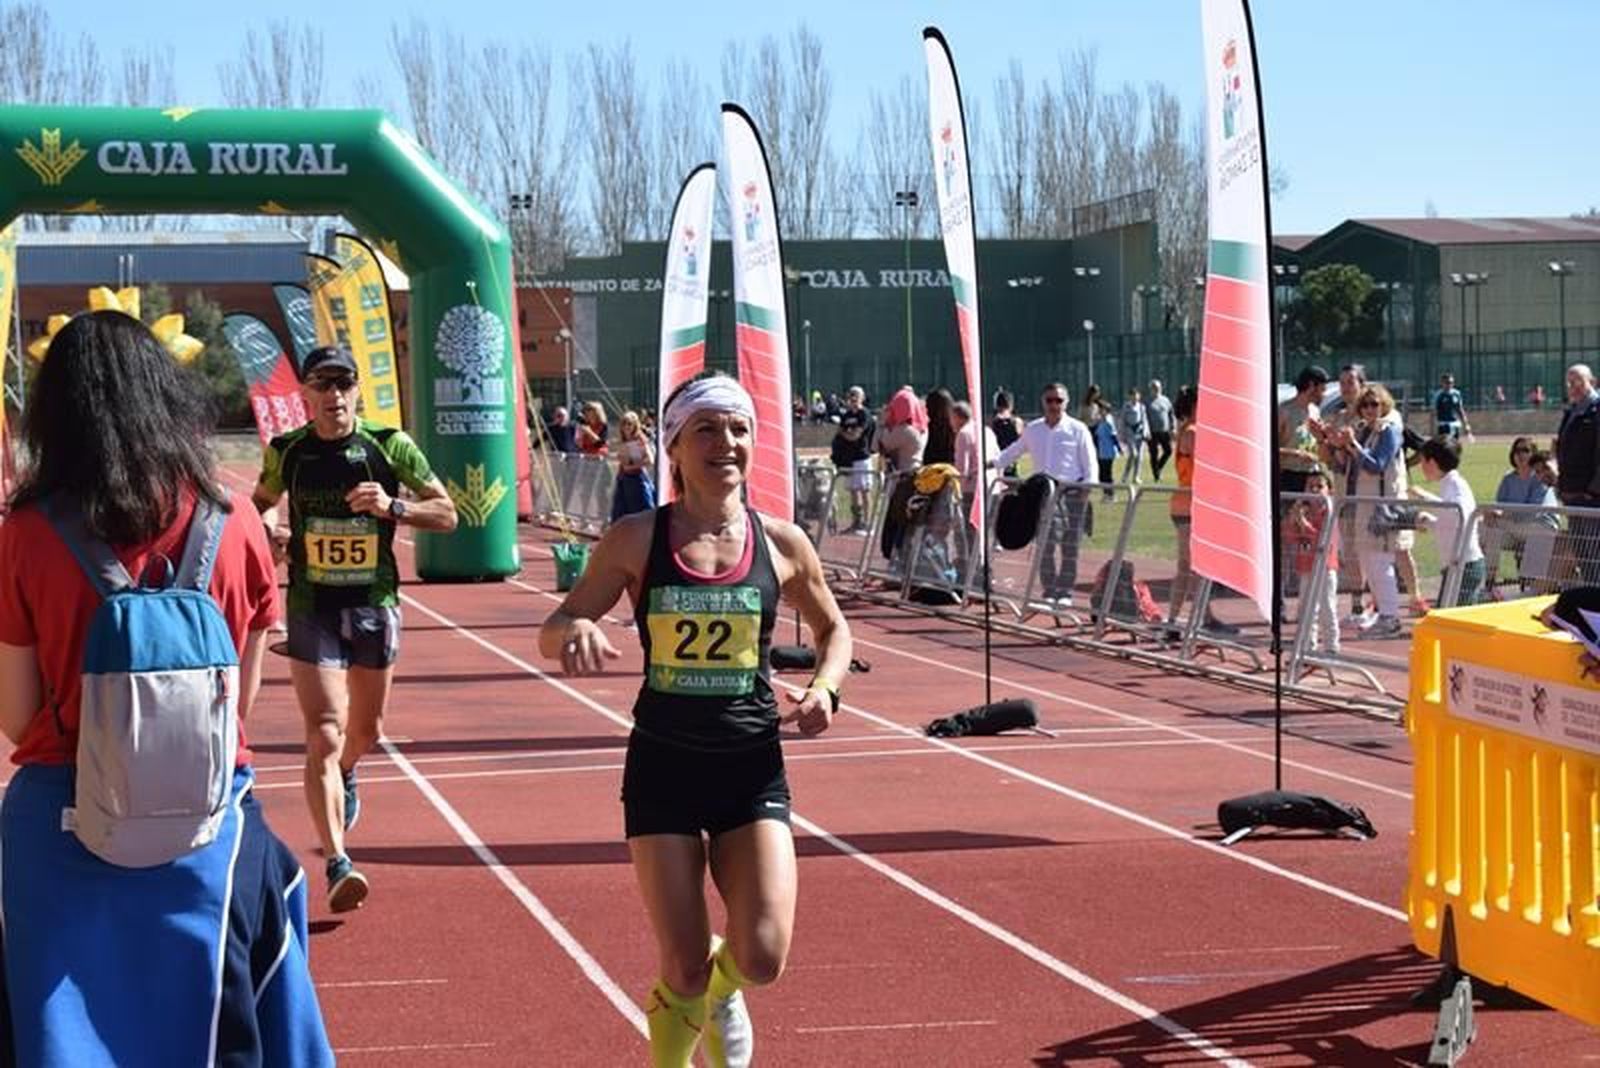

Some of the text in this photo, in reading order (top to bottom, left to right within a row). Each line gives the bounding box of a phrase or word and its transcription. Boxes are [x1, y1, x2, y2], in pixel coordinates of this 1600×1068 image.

[96, 141, 348, 176] CAJA RURAL
[621, 278, 641, 292] DE
[806, 269, 950, 288] CAJA RURA
[313, 538, 367, 565] 155
[674, 619, 732, 660] 22
